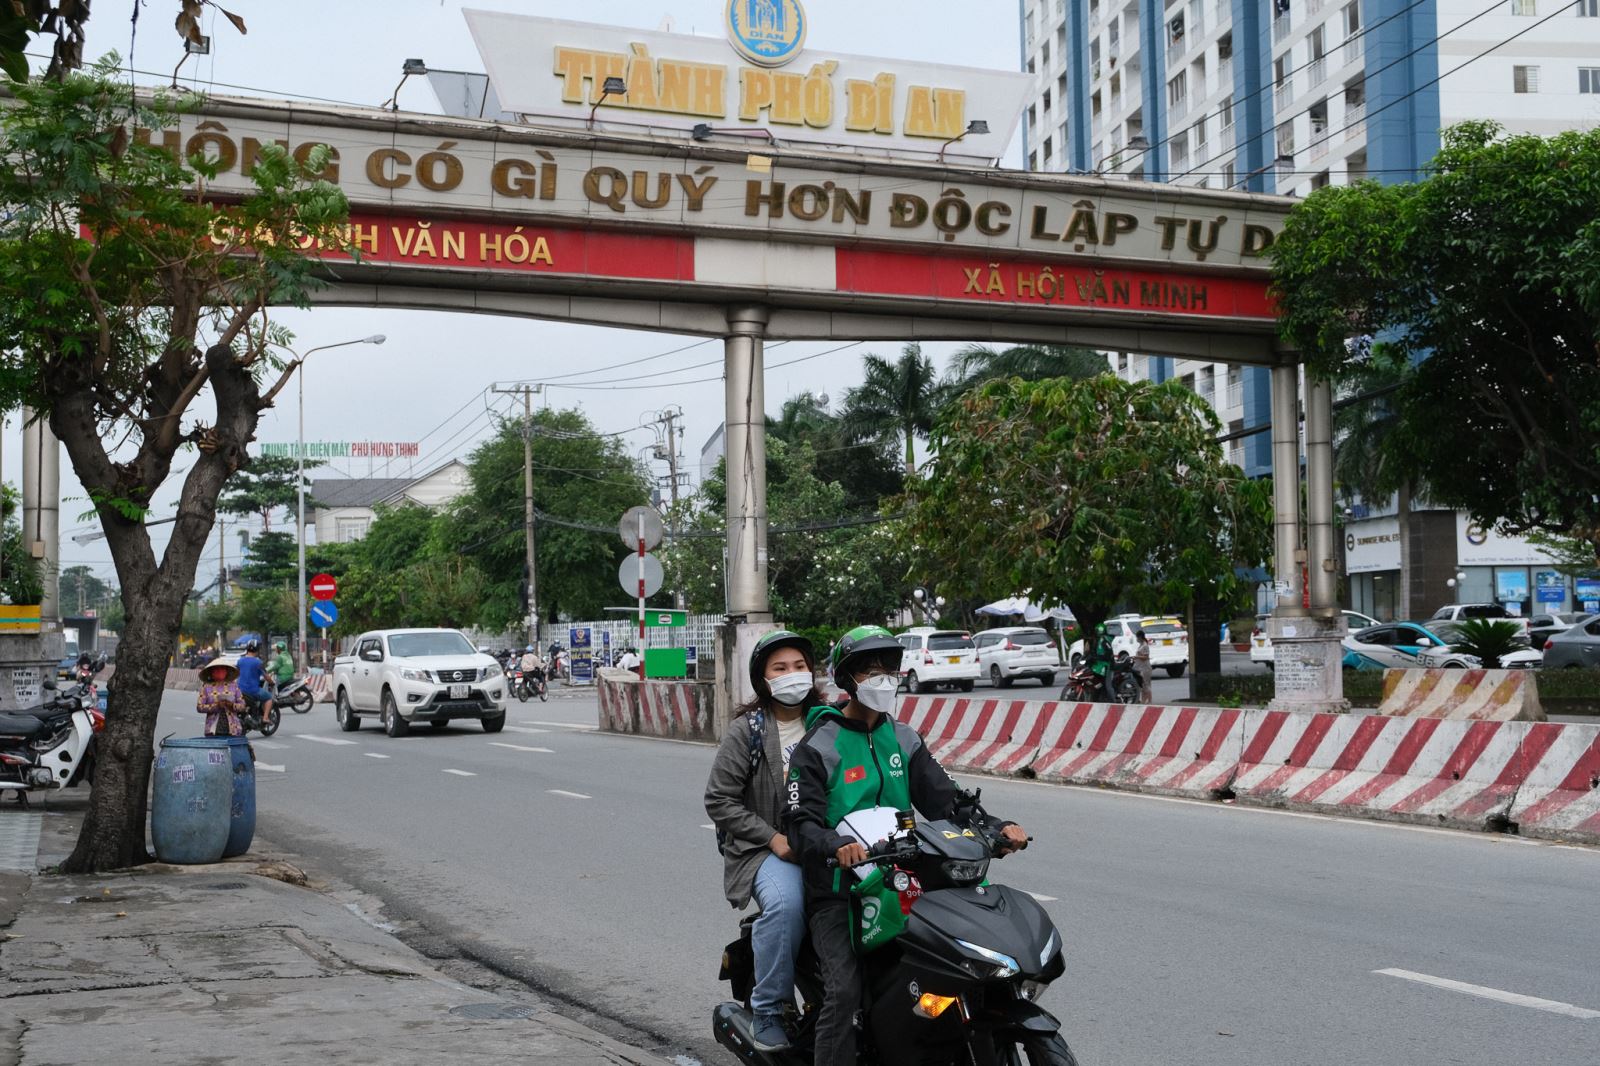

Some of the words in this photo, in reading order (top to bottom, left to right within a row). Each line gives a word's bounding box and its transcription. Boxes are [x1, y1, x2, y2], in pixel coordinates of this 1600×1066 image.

[554, 42, 727, 119] THÀNH
[738, 60, 839, 128] PHỐ
[903, 85, 966, 141] AN
[88, 120, 341, 184] HÔNG
[366, 141, 464, 191] CÓ
[491, 150, 558, 201] GÌ
[583, 166, 719, 213] QUÝ
[744, 180, 872, 225] HƠN
[888, 188, 1013, 242] ĐỘC
[1030, 200, 1139, 252] LẬP
[1154, 215, 1229, 261] TỰ
[1239, 223, 1276, 257] D
[392, 221, 466, 260] VĂN
[479, 226, 554, 265] HÓA
[963, 263, 1006, 296] XÃ
[1016, 266, 1066, 306] HỘI
[1074, 270, 1131, 305] VĂN
[1139, 280, 1208, 311] MINH
[260, 442, 288, 457] TRUNG
[290, 439, 307, 458] TÂM
[331, 440, 350, 457] MÁY
[351, 439, 369, 457] PHÚ
[370, 441, 394, 457] HƯNG
[395, 442, 419, 459] THỊNH
[906, 889, 924, 898] gof
